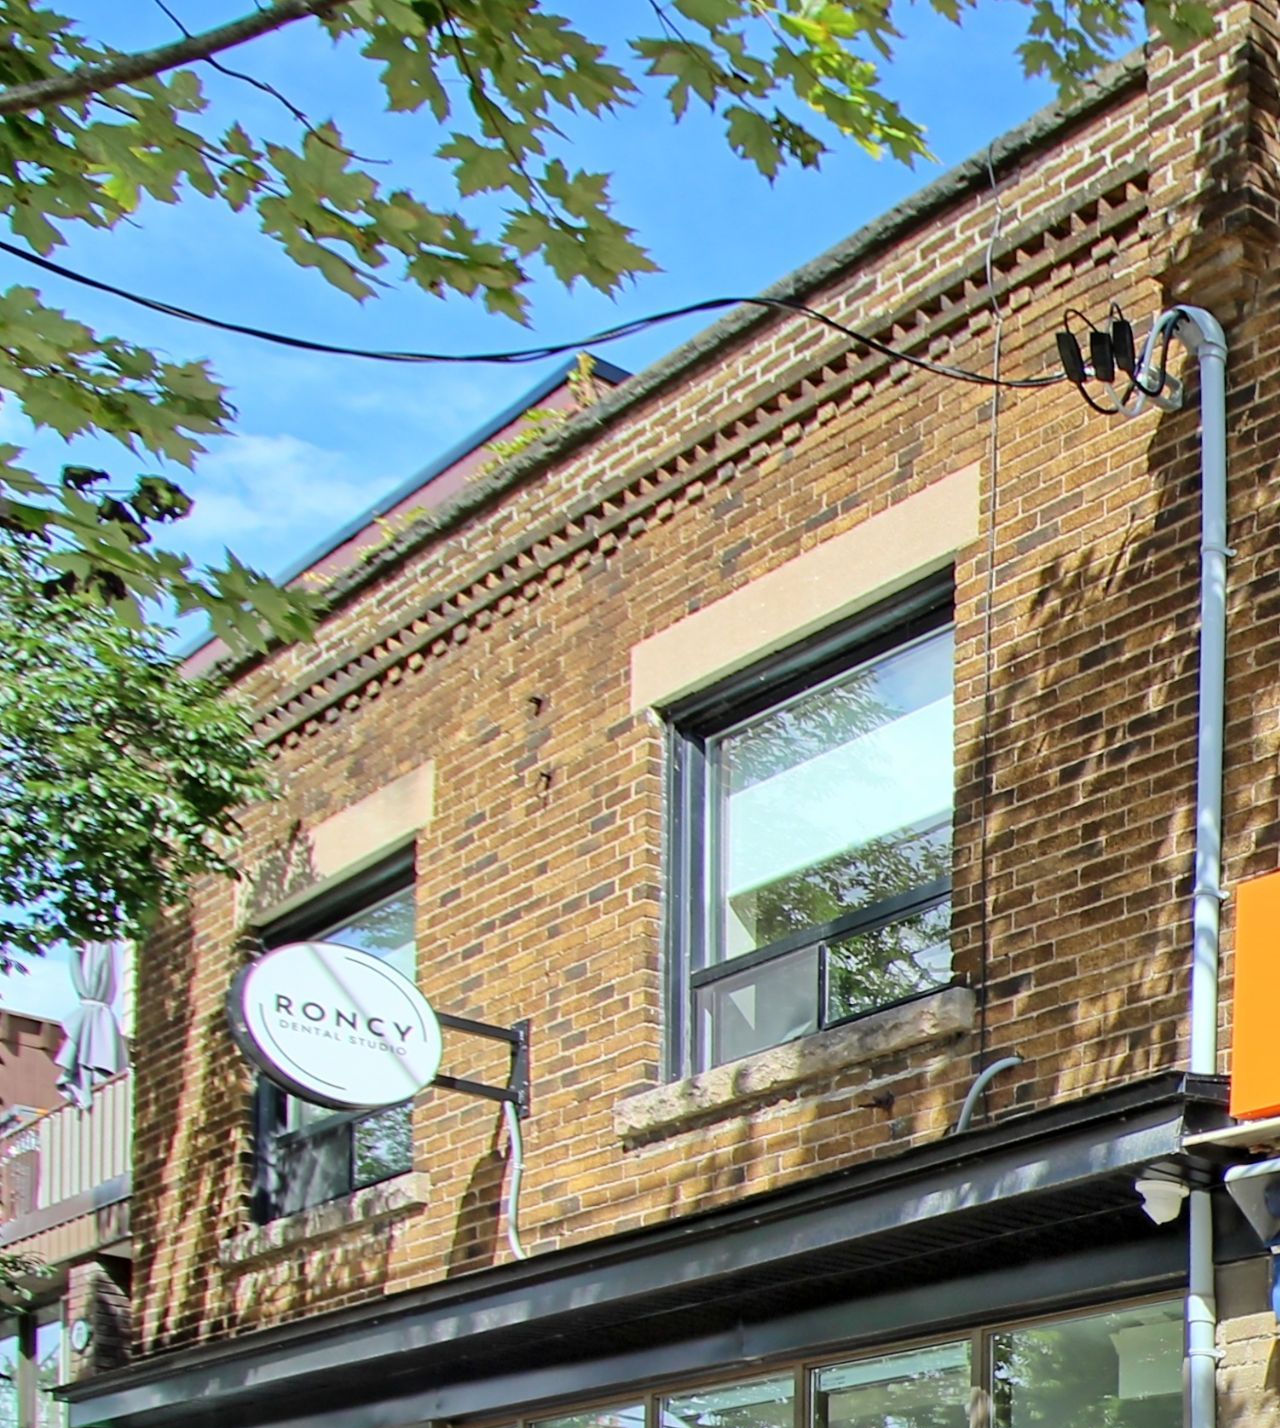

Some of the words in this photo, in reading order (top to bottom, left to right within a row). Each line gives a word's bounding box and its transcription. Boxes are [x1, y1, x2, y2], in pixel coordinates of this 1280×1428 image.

[275, 993, 413, 1043] RONCY
[279, 1019, 342, 1042] DENTAL
[349, 1035, 408, 1057] STUDIO
